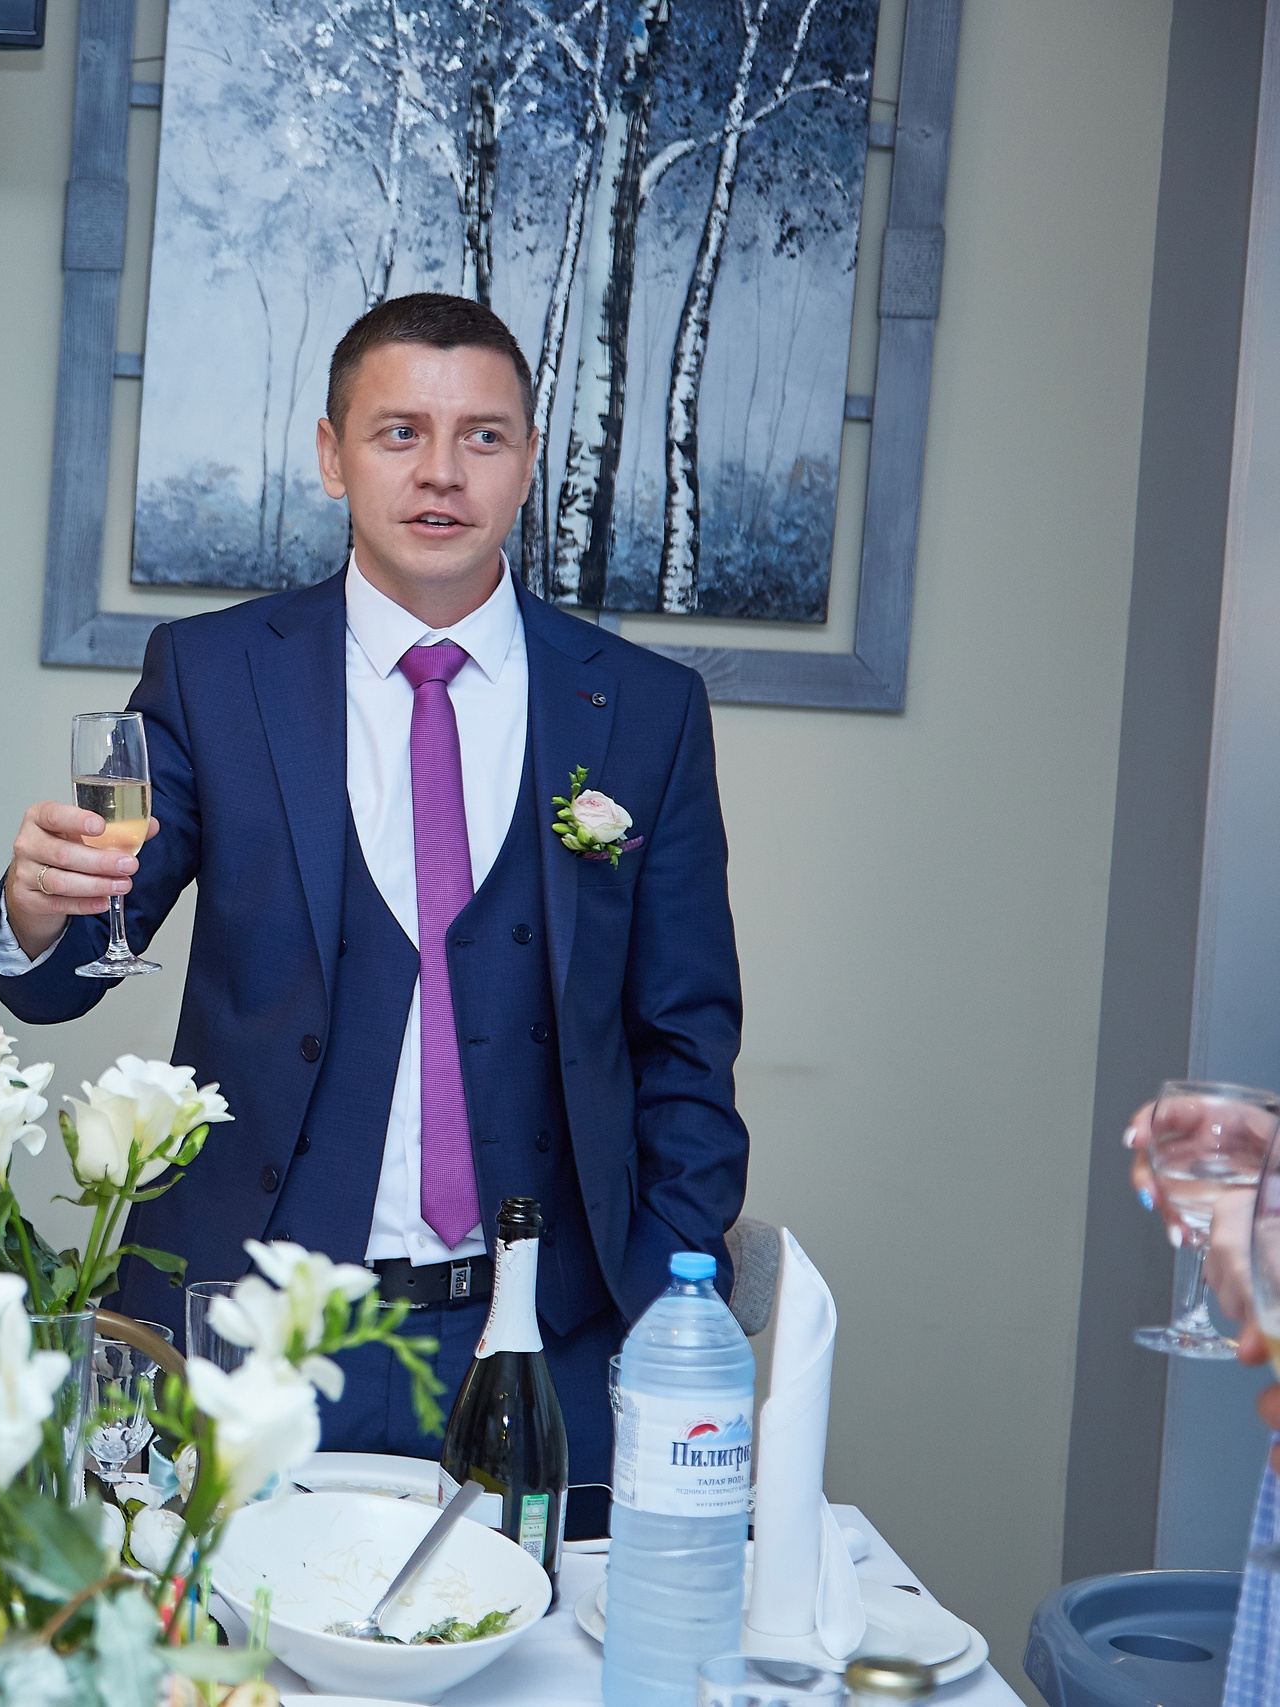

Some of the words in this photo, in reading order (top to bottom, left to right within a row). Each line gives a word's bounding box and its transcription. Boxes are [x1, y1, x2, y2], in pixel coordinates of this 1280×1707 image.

[455, 1270, 465, 1295] USPA
[670, 1441, 751, 1472] Пилигри
[697, 1478, 726, 1486] ТАЛАЯ
[708, 1486, 739, 1495] СЕВЕРНОГО
